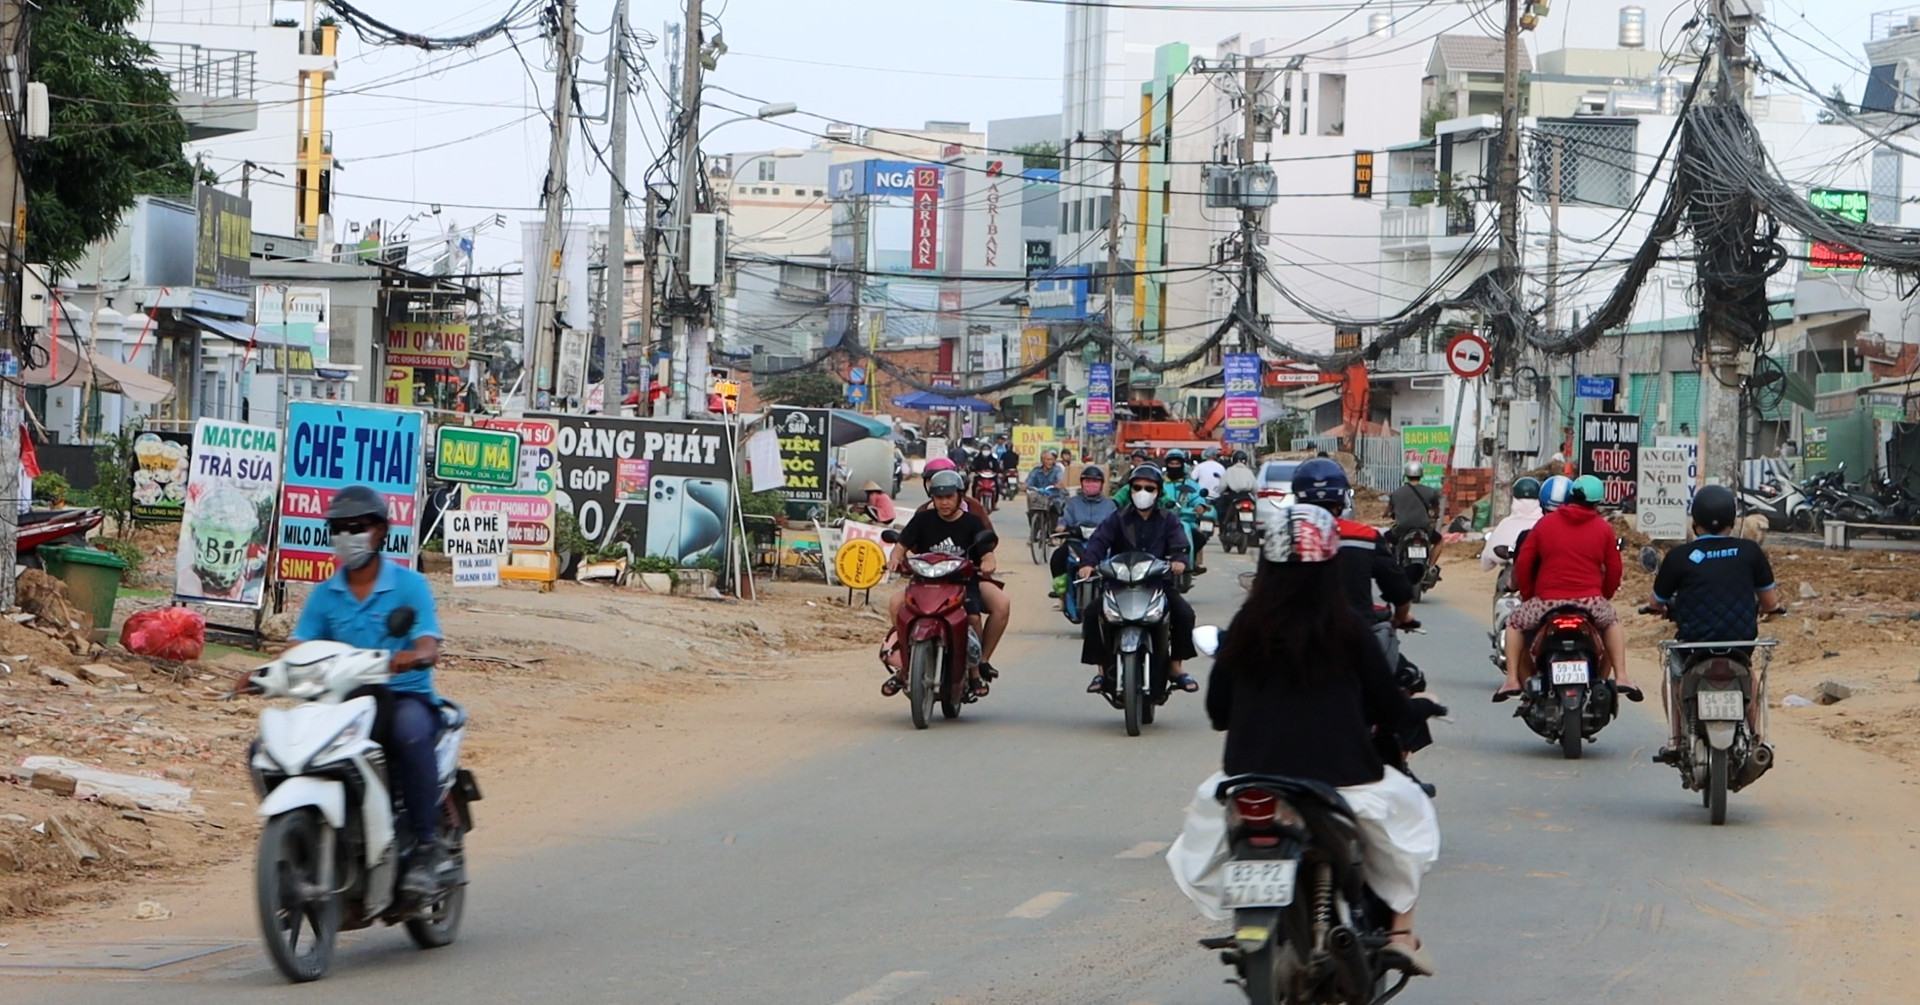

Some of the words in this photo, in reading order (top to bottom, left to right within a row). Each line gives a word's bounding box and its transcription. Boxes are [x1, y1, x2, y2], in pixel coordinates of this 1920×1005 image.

[876, 170, 915, 188] NGÂ
[918, 192, 932, 265] AGRIBANK
[986, 183, 999, 267] AGRIBANK
[388, 326, 407, 348] MÌ
[401, 356, 420, 365] 0965
[202, 425, 277, 452] MATCHA
[534, 423, 552, 443] SỨ
[1601, 416, 1618, 442] TÓC
[1618, 421, 1638, 443] NAM
[293, 410, 347, 480] CHÈ
[354, 415, 414, 485] THÁI
[557, 422, 636, 459] OÀNG
[642, 428, 721, 465] PHÁT
[441, 439, 480, 468] RAU
[481, 438, 511, 471] MÁ
[781, 456, 815, 472] TÓC
[1591, 443, 1631, 474] TRÚC
[1641, 450, 1659, 462] AN
[1661, 450, 1685, 462] GIA
[199, 453, 232, 478] TRÀ
[237, 455, 274, 482] SỮA
[569, 465, 611, 491] GÓP
[1643, 469, 1682, 486] Nệm
[783, 475, 819, 488] AM
[287, 489, 322, 515] TRÀ
[388, 497, 411, 522] ÂY
[500, 500, 529, 516] PHONG
[530, 502, 548, 518] LAN
[1639, 497, 1684, 506] FUJIKA
[453, 513, 471, 532] CÀ
[474, 513, 499, 532] PHÊ
[284, 525, 311, 546] MILO
[447, 539, 473, 554] PHA
[476, 535, 505, 555] MÁY
[1706, 547, 1739, 558] SHBET
[281, 557, 313, 580] SINH
[317, 555, 336, 580] TỐ
[455, 573, 480, 583] CHANH
[1705, 705, 1737, 718] 3385
